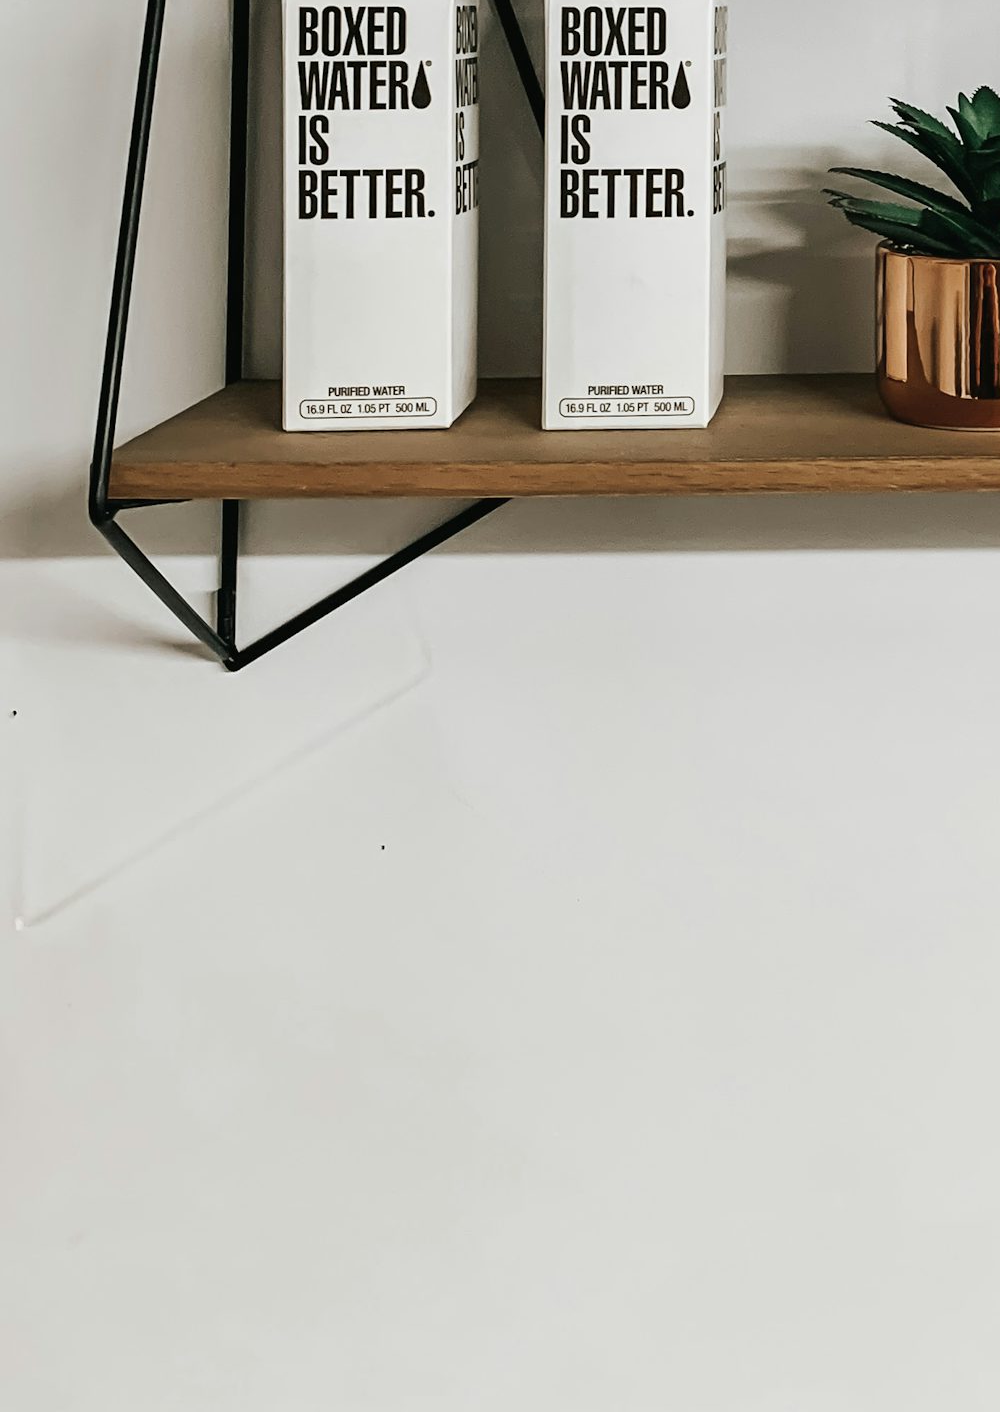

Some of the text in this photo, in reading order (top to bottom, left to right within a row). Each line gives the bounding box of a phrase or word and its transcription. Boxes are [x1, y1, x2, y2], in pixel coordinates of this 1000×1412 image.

[299, 6, 406, 57] BOXED
[561, 6, 666, 57] BOXED
[298, 61, 409, 110] WATER
[560, 61, 669, 110] WATER
[299, 115, 329, 165] IS
[455, 111, 465, 162] IS
[561, 114, 590, 165] IS
[299, 169, 435, 219] BETTER.
[560, 169, 694, 218] BETTER.
[306, 402, 429, 415] 16.9 FL OZ 1.05 PT 500 ML
[328, 385, 405, 397] PURIFIED WATER
[566, 401, 687, 413] 16.9 FL OZ 1.05 PT 500 ML
[588, 384, 664, 395] PURIFIED WATER
